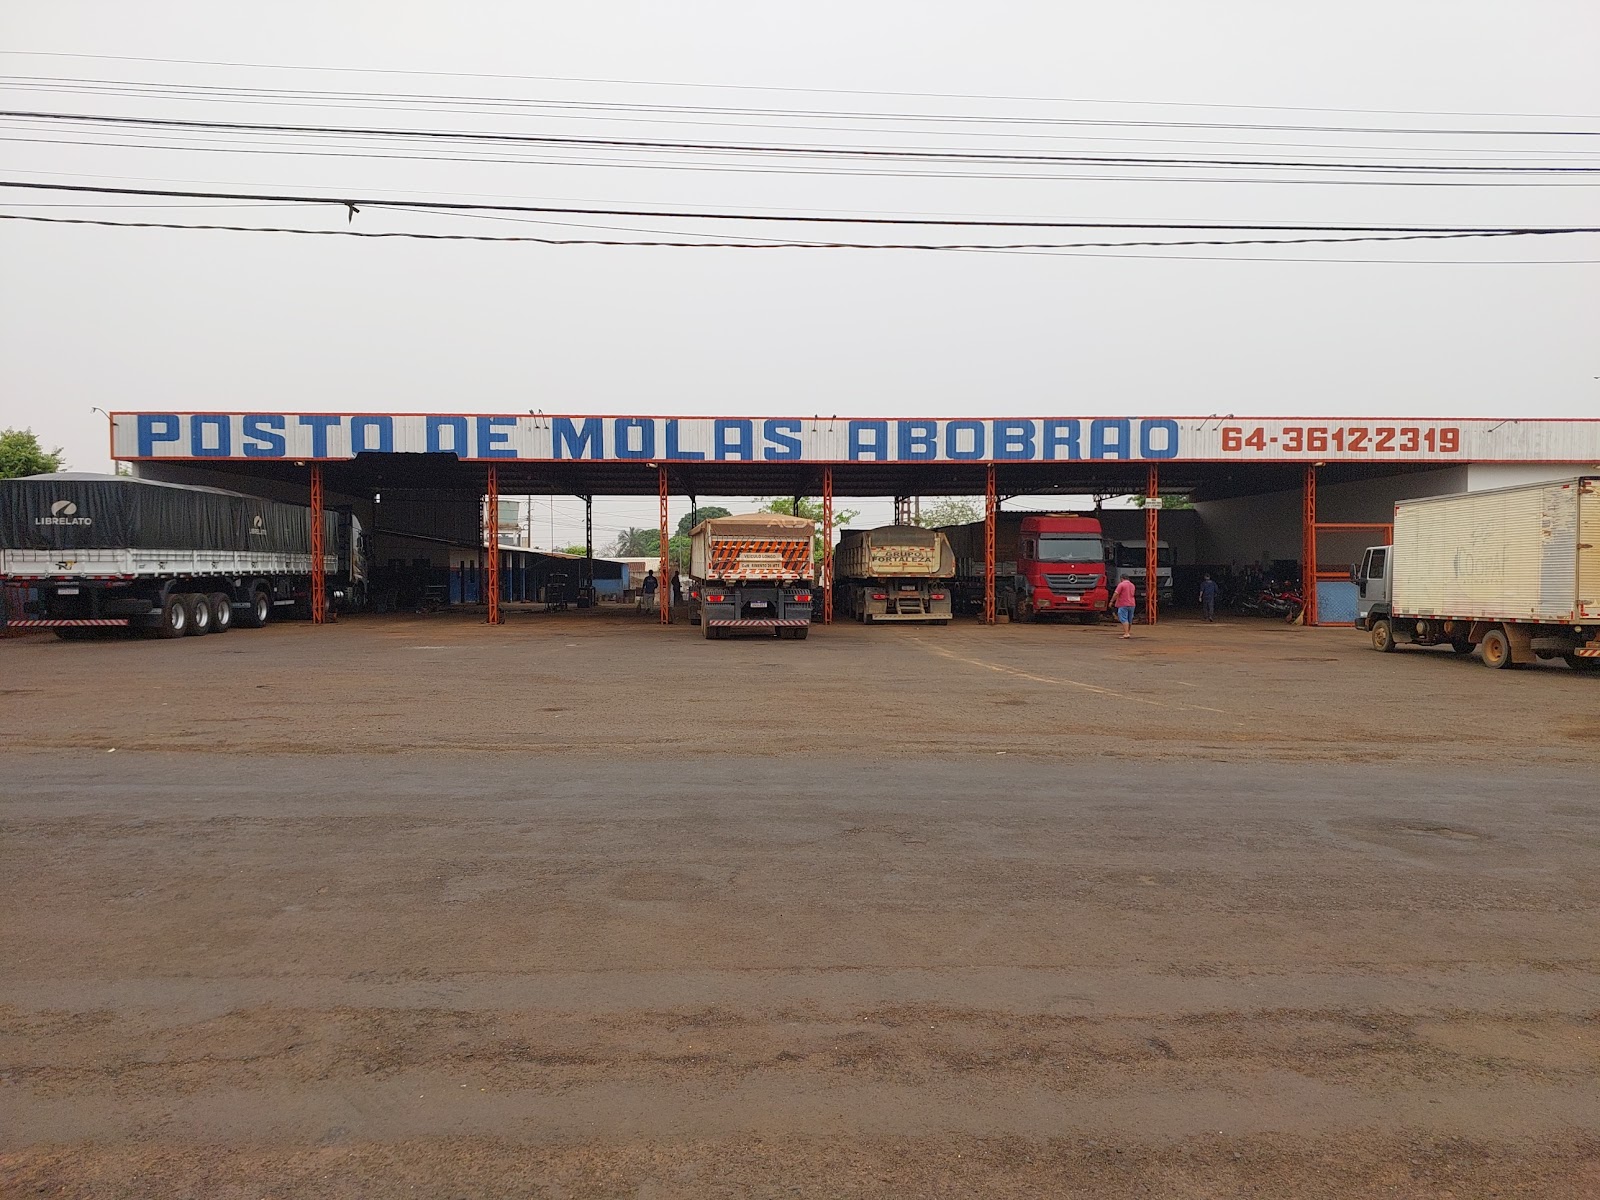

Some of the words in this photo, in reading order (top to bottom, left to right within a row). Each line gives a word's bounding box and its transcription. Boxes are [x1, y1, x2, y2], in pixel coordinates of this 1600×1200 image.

[137, 414, 393, 457] POSTO
[426, 416, 517, 457] DE
[552, 418, 801, 460] MOLAS
[35, 517, 92, 525] LIBRELATO
